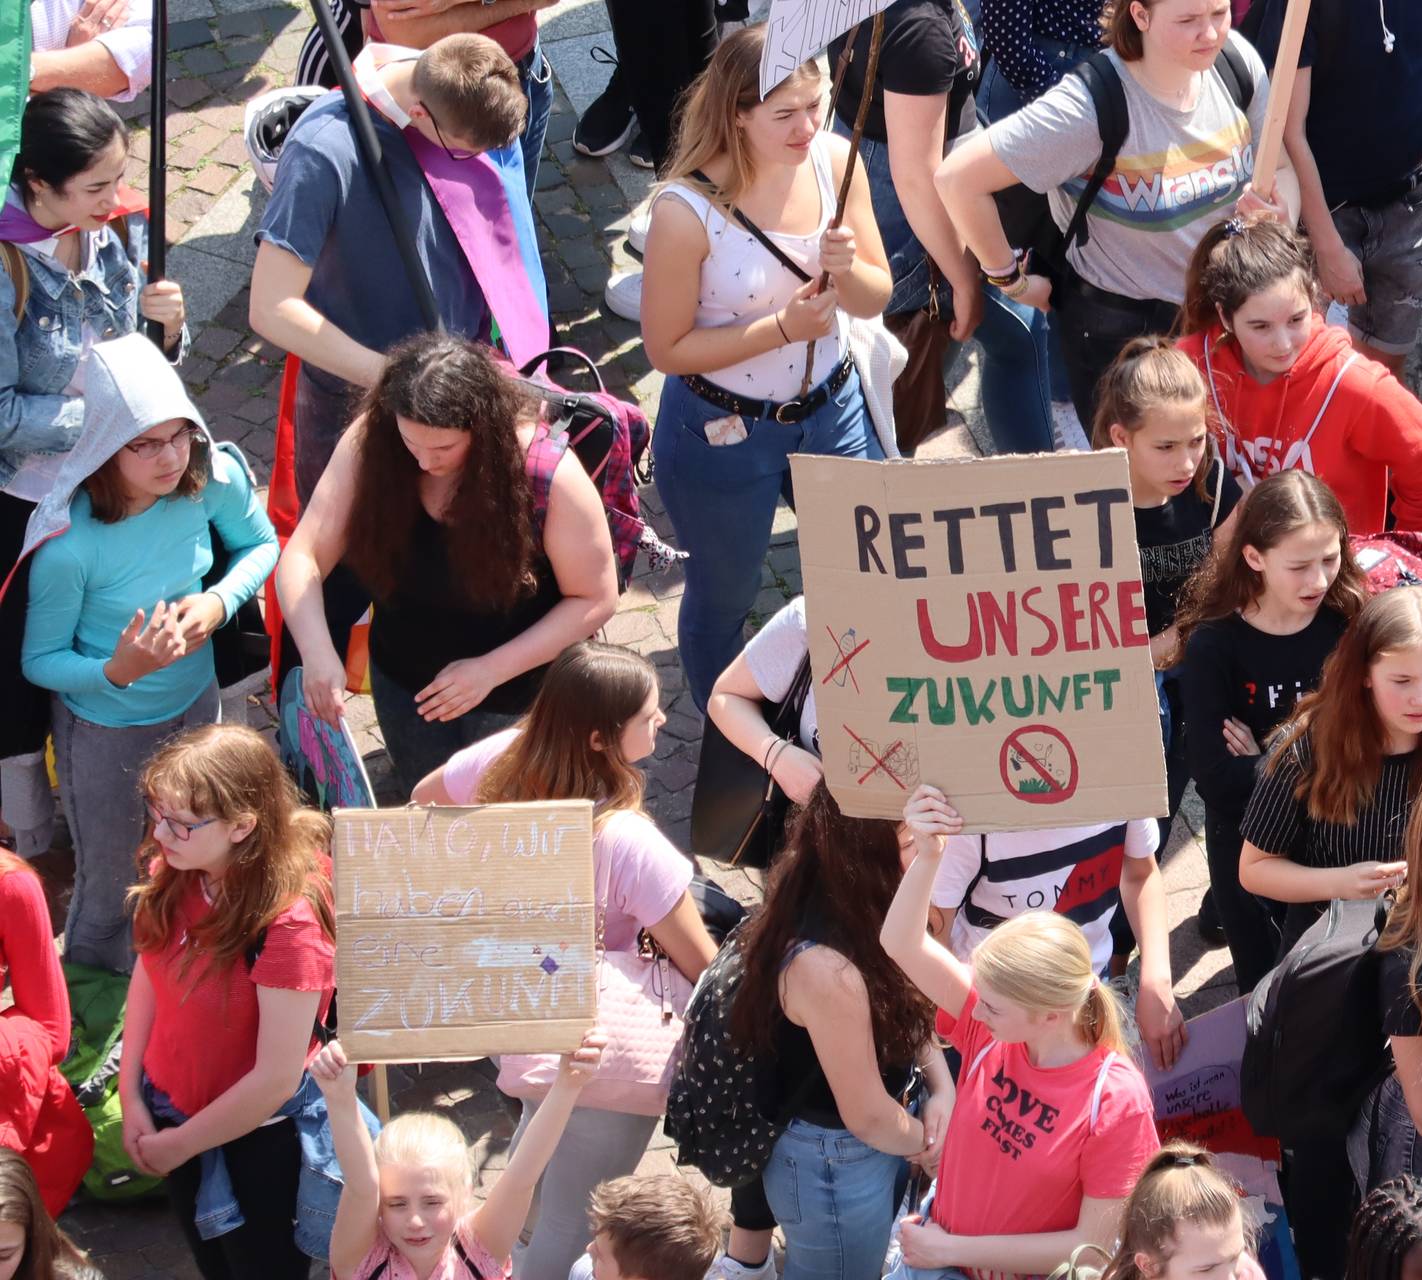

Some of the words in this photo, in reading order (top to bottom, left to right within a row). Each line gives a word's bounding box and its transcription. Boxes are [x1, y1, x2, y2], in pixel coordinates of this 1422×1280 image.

[854, 488, 1129, 579] RETTET
[916, 580, 1150, 663] UNSERE
[886, 669, 1121, 726] ZUKUNFT
[1001, 864, 1109, 908] TOMMY
[353, 971, 591, 1034] ZUKUNFT
